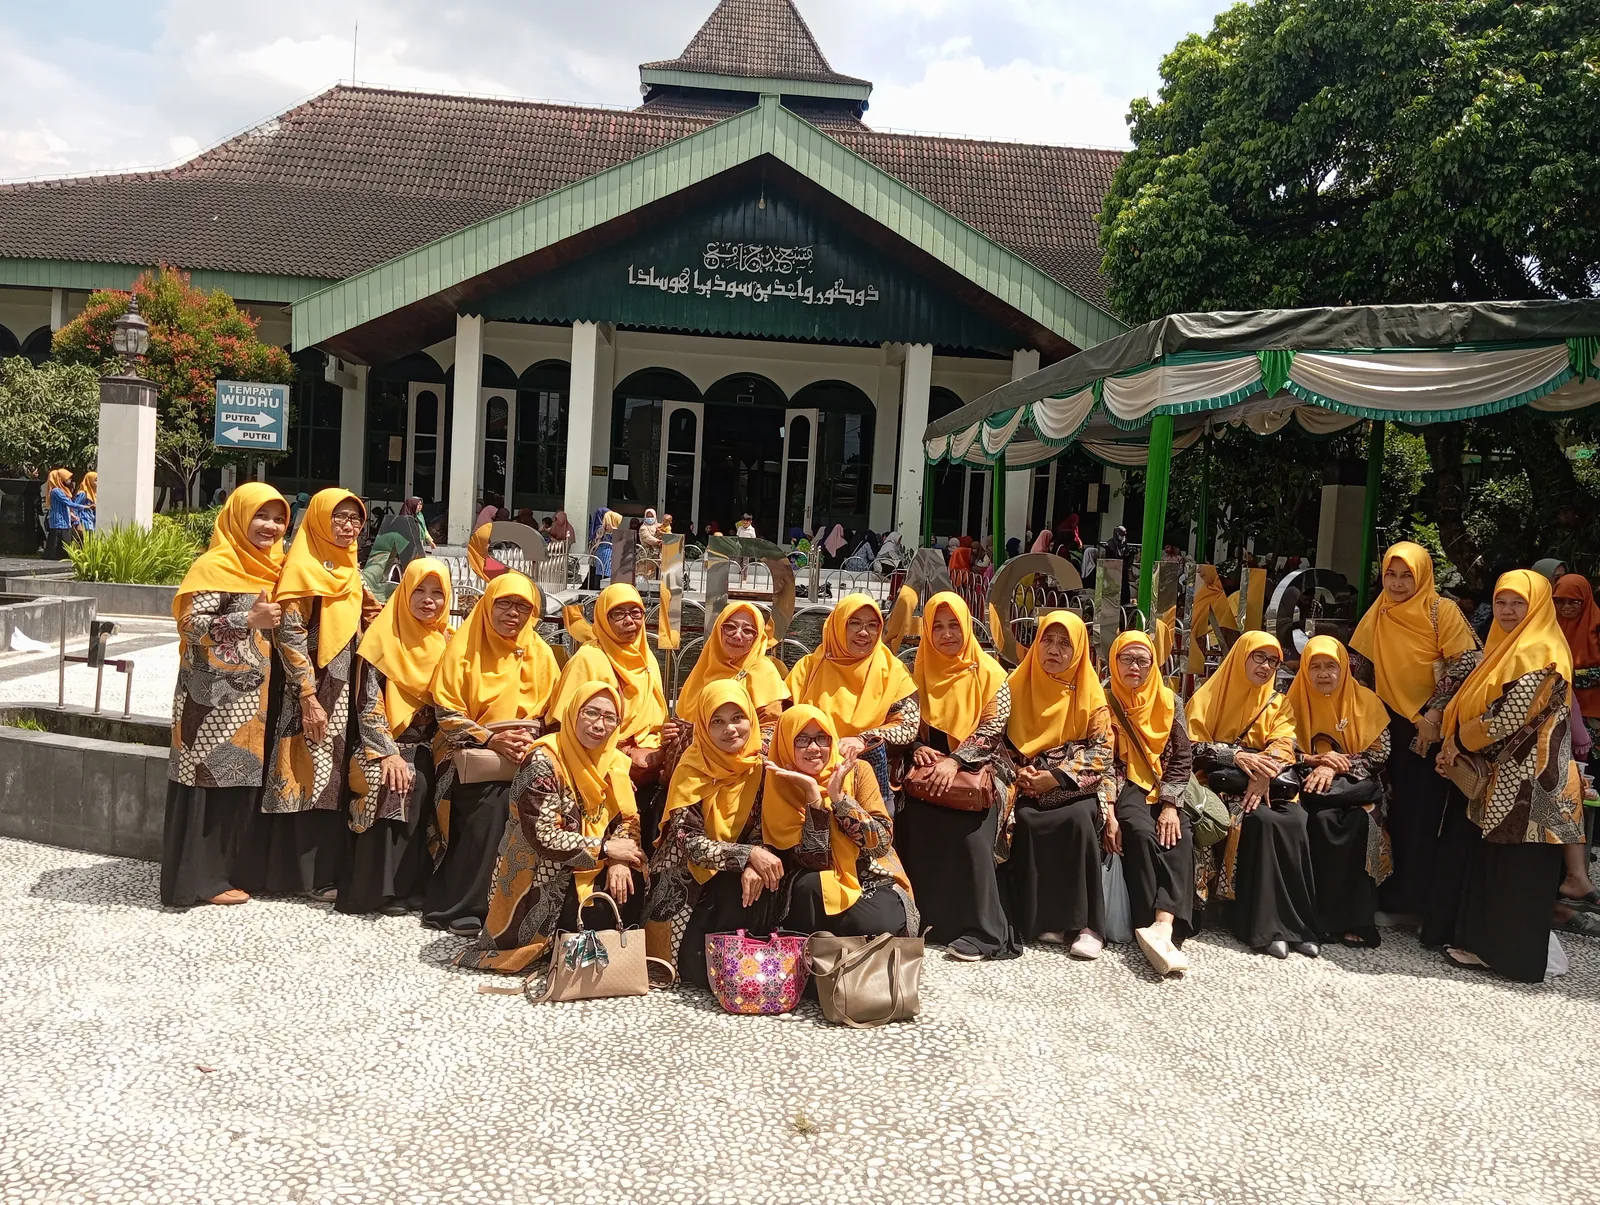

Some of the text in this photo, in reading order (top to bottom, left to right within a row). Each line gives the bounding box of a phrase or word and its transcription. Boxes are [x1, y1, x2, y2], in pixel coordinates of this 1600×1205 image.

[228, 386, 274, 397] TEMPAT
[221, 395, 280, 408] WUDHU
[225, 415, 257, 423] PUTRA
